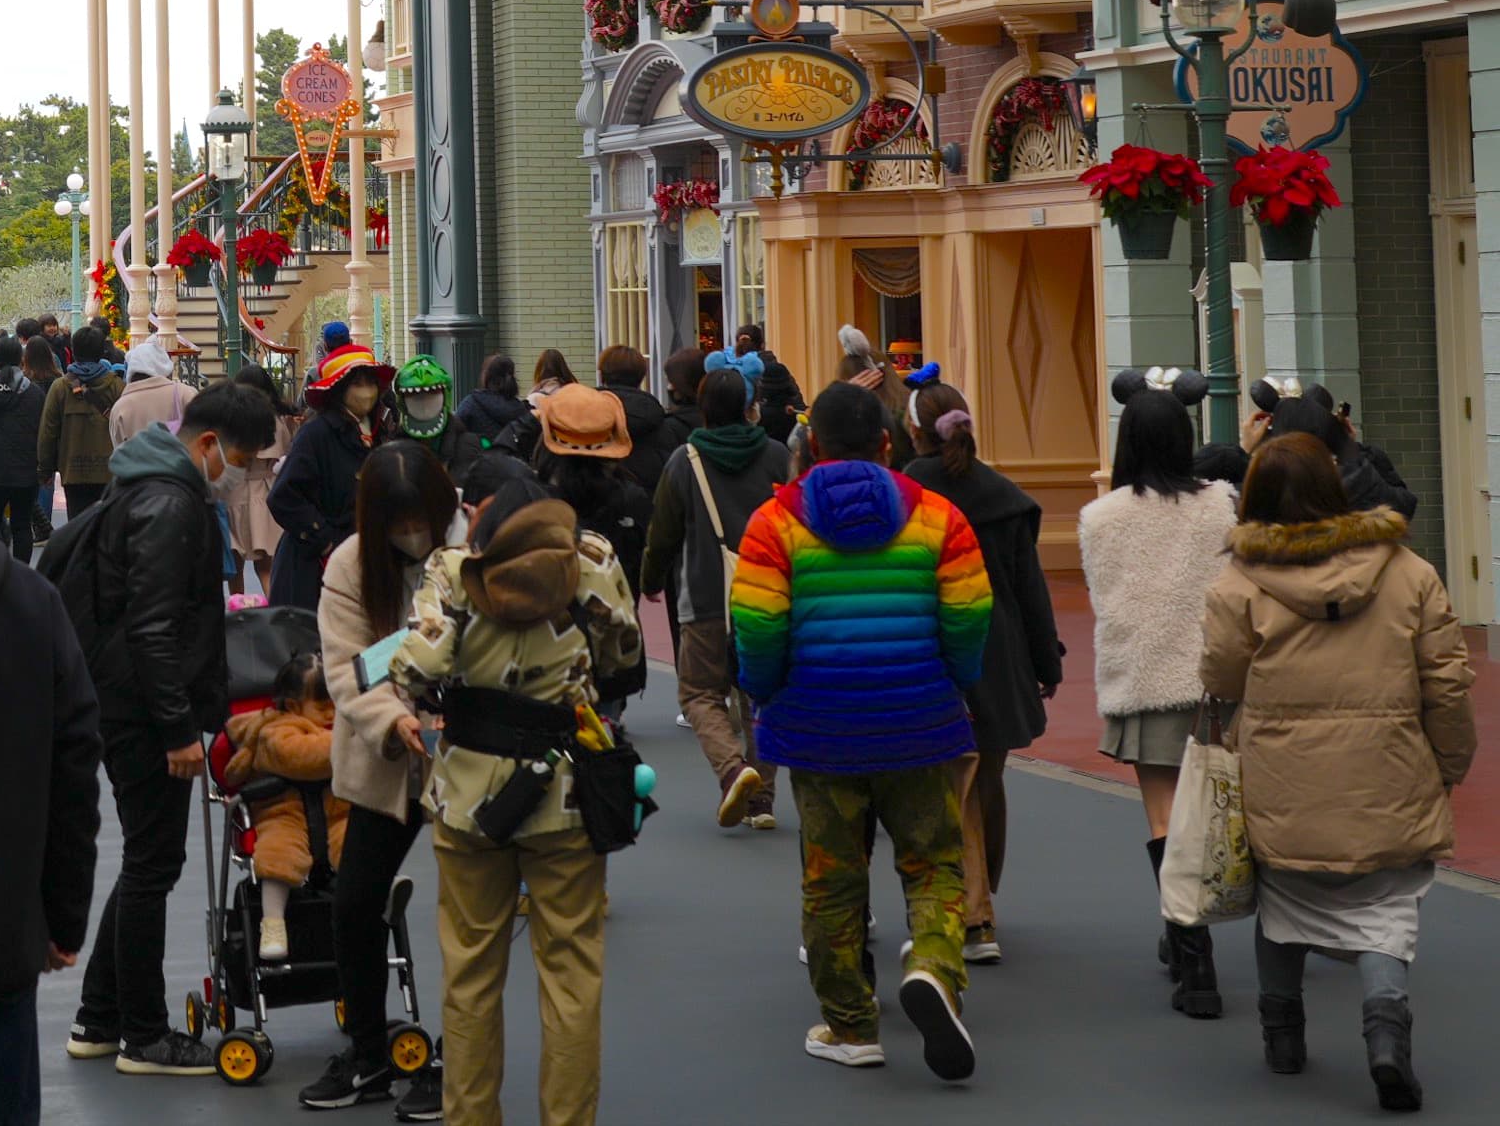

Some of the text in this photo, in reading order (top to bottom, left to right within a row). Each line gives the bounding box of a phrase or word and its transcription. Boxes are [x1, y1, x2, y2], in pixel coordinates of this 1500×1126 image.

[1228, 48, 1328, 65] STAURANT
[308, 64, 326, 76] ICE
[296, 77, 338, 89] CREAM
[703, 55, 854, 105] PASTRY PALACE
[1233, 67, 1334, 105] OKUSAI
[297, 91, 337, 103] CONES
[764, 112, 804, 122] ユーハイム
